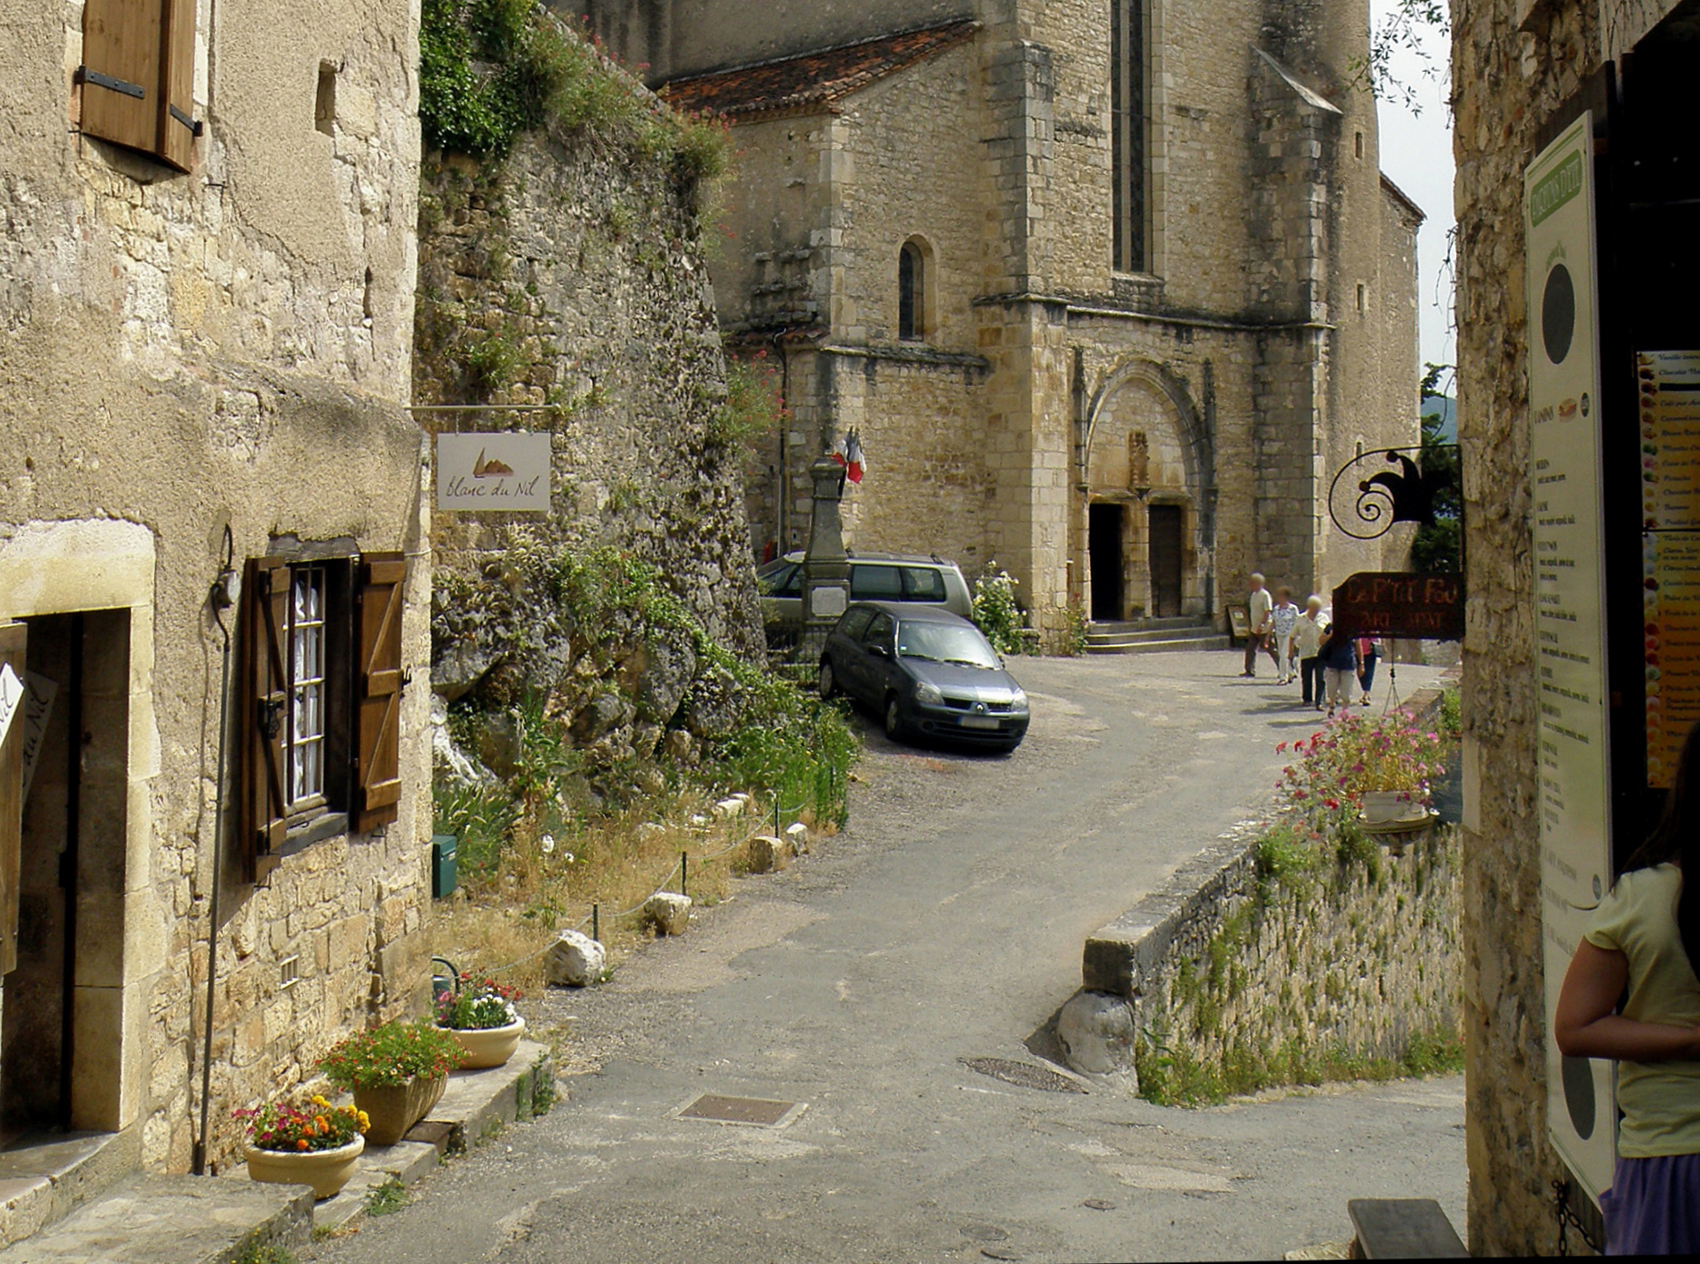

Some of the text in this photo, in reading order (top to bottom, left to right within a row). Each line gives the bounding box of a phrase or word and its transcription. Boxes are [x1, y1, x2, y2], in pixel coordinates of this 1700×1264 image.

[491, 478, 509, 497] du
[514, 475, 540, 498] Nil
[27, 681, 49, 732] Nil
